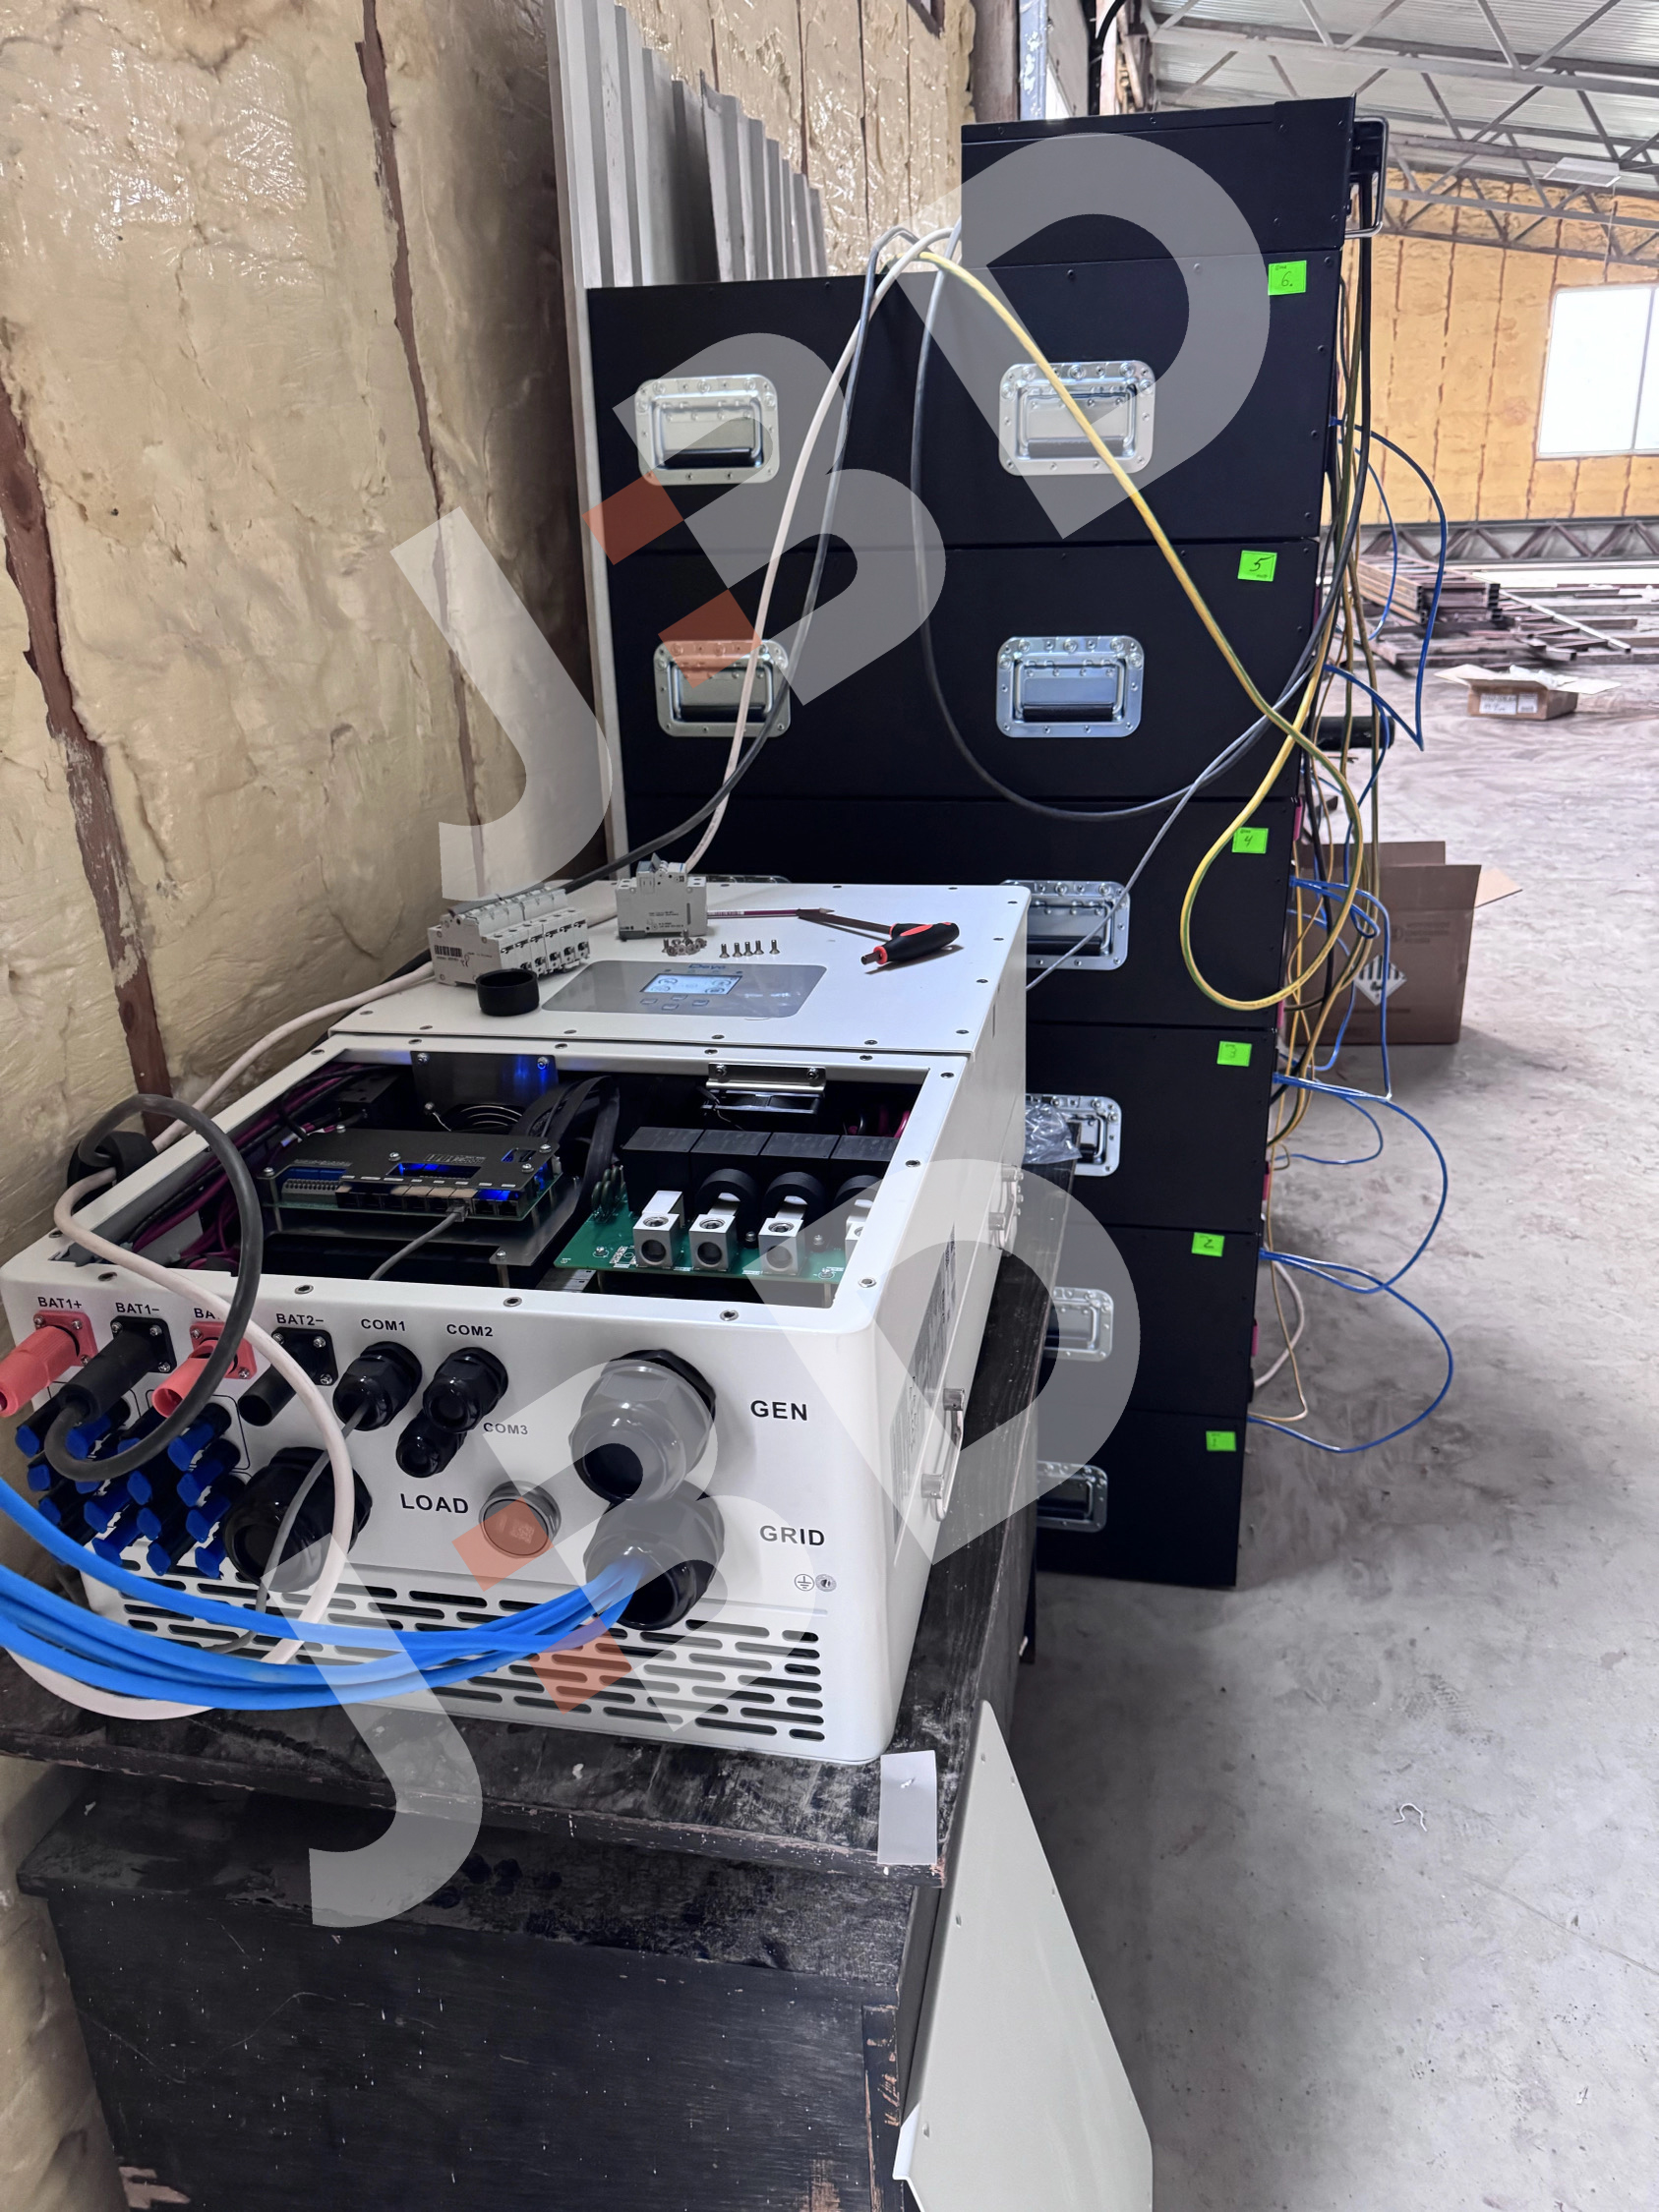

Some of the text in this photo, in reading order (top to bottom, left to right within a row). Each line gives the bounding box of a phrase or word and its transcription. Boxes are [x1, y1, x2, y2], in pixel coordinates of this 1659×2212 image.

[1249, 554, 1274, 572] 5
[1243, 835, 1254, 847] 4
[37, 1297, 82, 1310] BAT1+
[115, 1303, 159, 1314] BAT1-
[275, 1313, 324, 1325] BAT2-
[360, 1318, 406, 1331] COM1
[446, 1324, 493, 1337] COM2
[750, 1400, 807, 1421] GEN
[483, 1423, 528, 1435] COM3
[400, 1493, 469, 1514] LOAD
[759, 1525, 825, 1546] GRID
